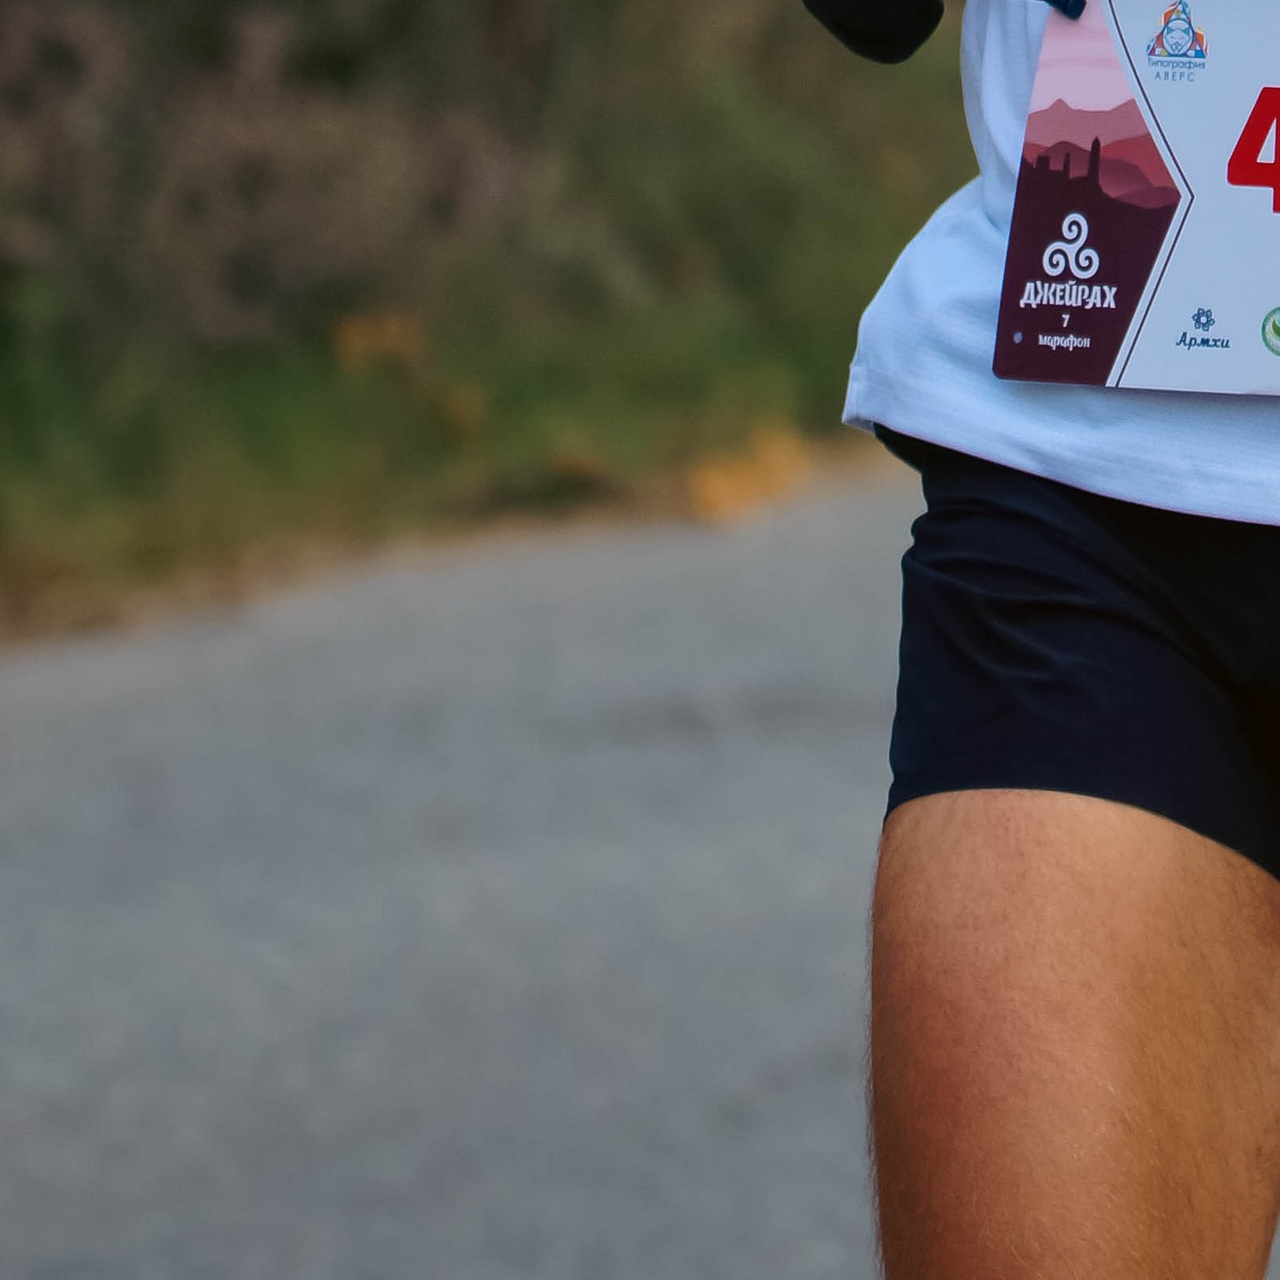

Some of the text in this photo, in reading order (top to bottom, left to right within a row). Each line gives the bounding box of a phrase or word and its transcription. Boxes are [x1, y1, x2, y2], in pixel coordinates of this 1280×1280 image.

[1147, 57, 1206, 70] Типография
[1154, 71, 1196, 82] АВЕРС
[1019, 280, 1118, 309] ДЖЕЙРАХ
[1062, 313, 1070, 328] 7
[1038, 334, 1091, 351] марафон
[1175, 331, 1231, 351] Армхи
